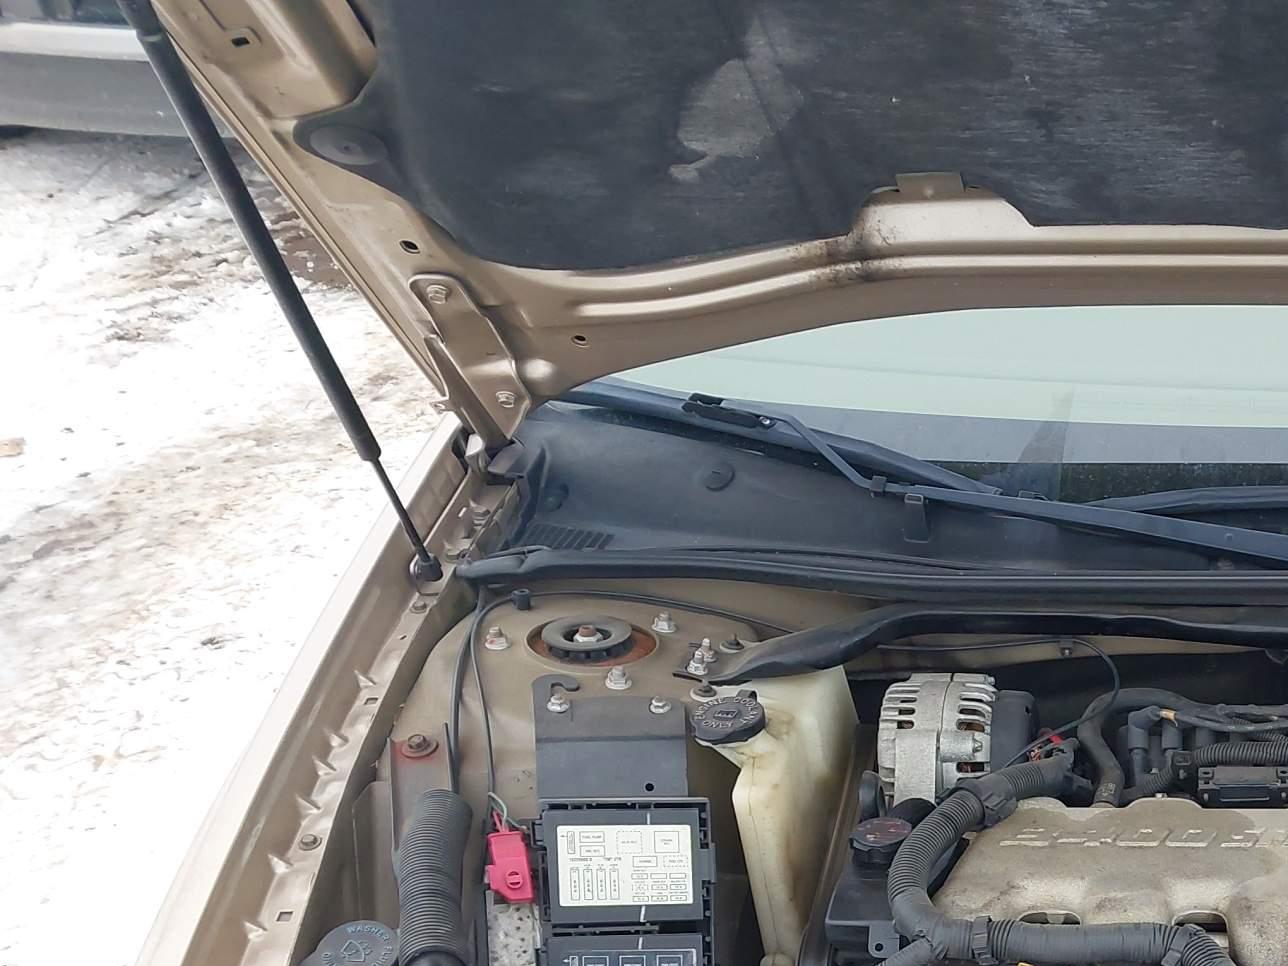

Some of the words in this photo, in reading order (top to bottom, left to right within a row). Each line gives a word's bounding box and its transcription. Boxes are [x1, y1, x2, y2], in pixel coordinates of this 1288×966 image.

[694, 697, 727, 720] ENGINE
[733, 697, 760, 725] COOLANT
[703, 719, 734, 729] ONLY
[347, 925, 391, 942] WASHER
